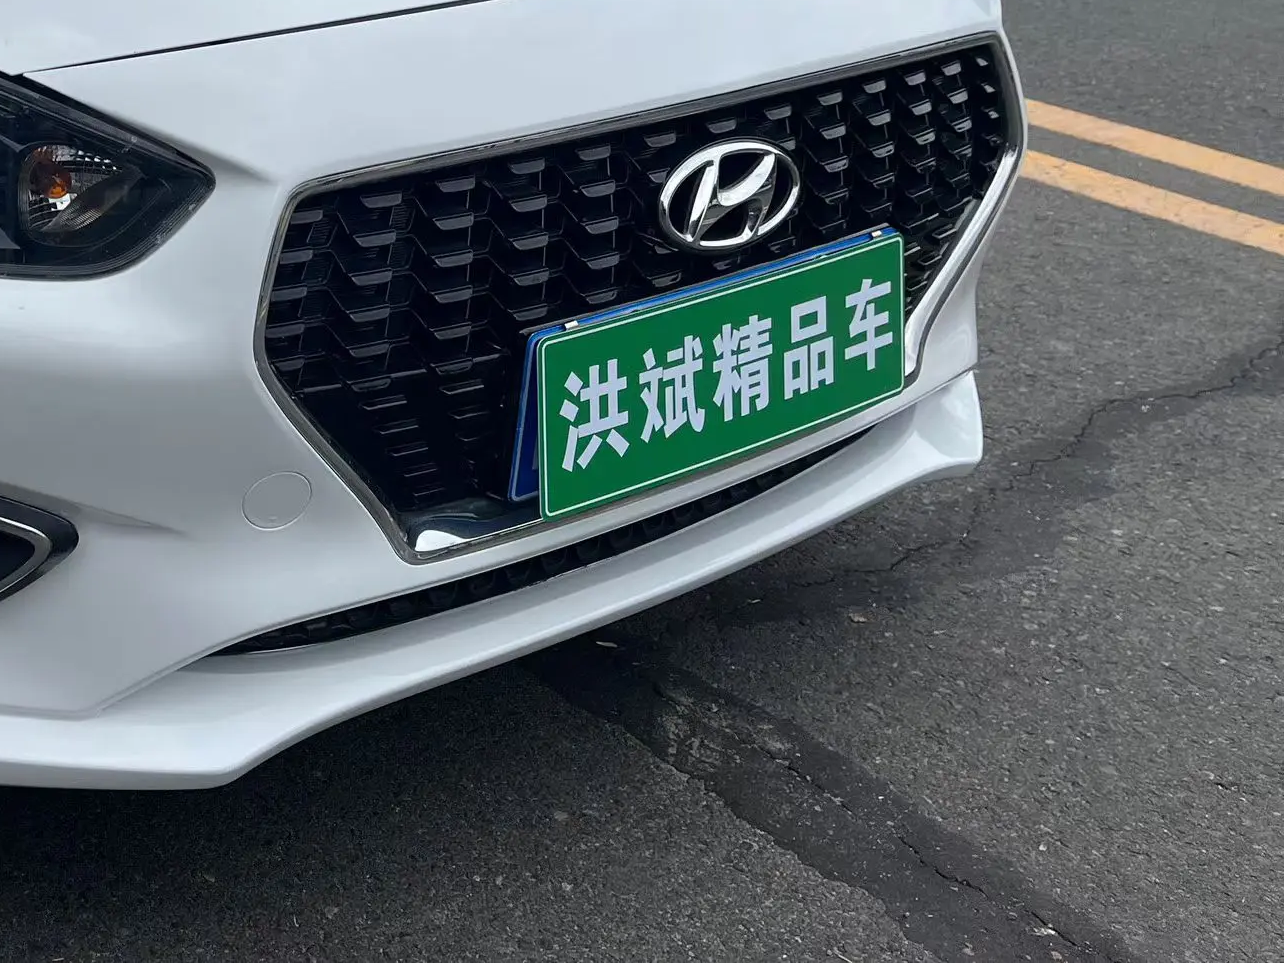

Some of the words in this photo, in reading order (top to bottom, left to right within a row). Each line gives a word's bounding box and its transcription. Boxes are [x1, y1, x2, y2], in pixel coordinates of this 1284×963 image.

[558, 278, 894, 473] 洪斌精品车
